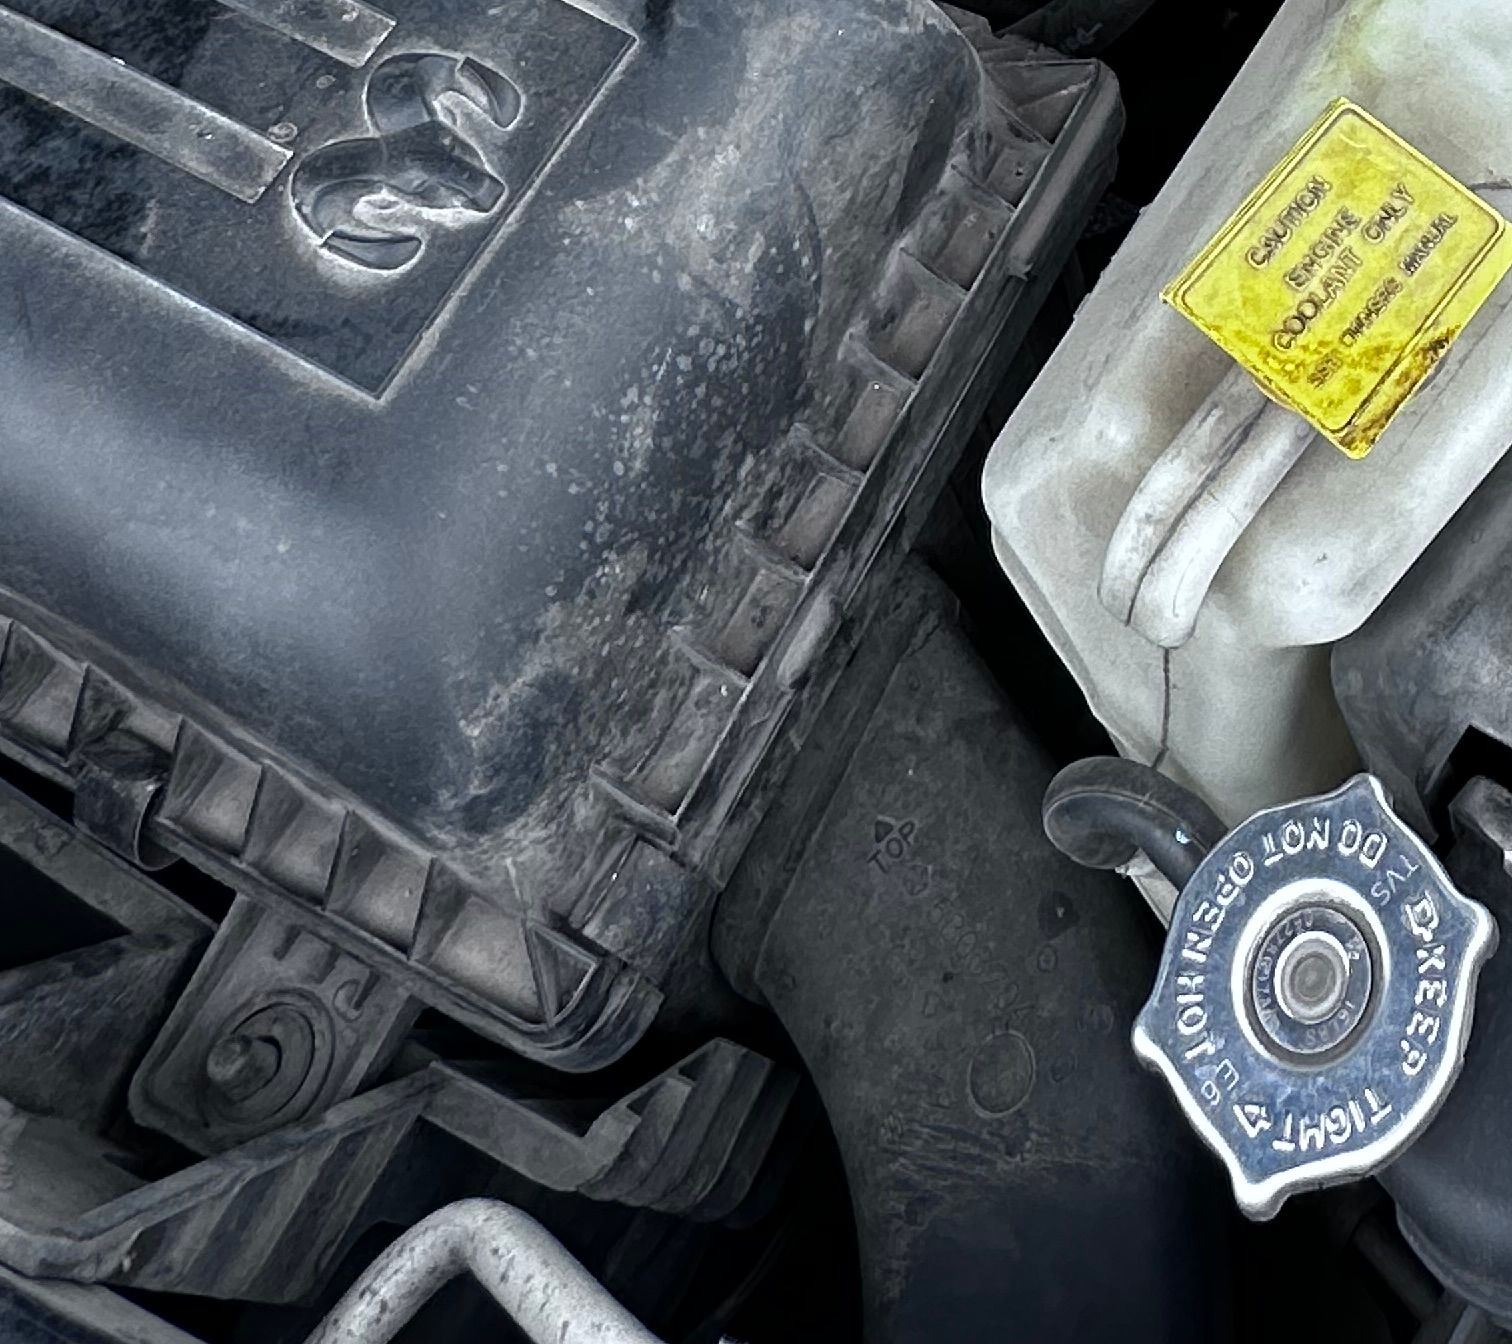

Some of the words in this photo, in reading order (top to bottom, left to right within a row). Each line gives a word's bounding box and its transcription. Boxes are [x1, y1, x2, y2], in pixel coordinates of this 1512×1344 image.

[1242, 172, 1332, 271] CAUTION
[1283, 204, 1362, 293] ENGINE
[1268, 244, 1365, 355] COOLANT
[1358, 180, 1418, 247] ONLY
[866, 820, 917, 874] TOP
[1263, 817, 1331, 868] NOT
[1337, 819, 1390, 869] DO
[1370, 854, 1420, 908] TVS
[1188, 852, 1255, 966] OPEN
[1175, 965, 1217, 1062] HOT
[1402, 936, 1450, 1076] KEEP
[1273, 1086, 1395, 1152] TIGHT
